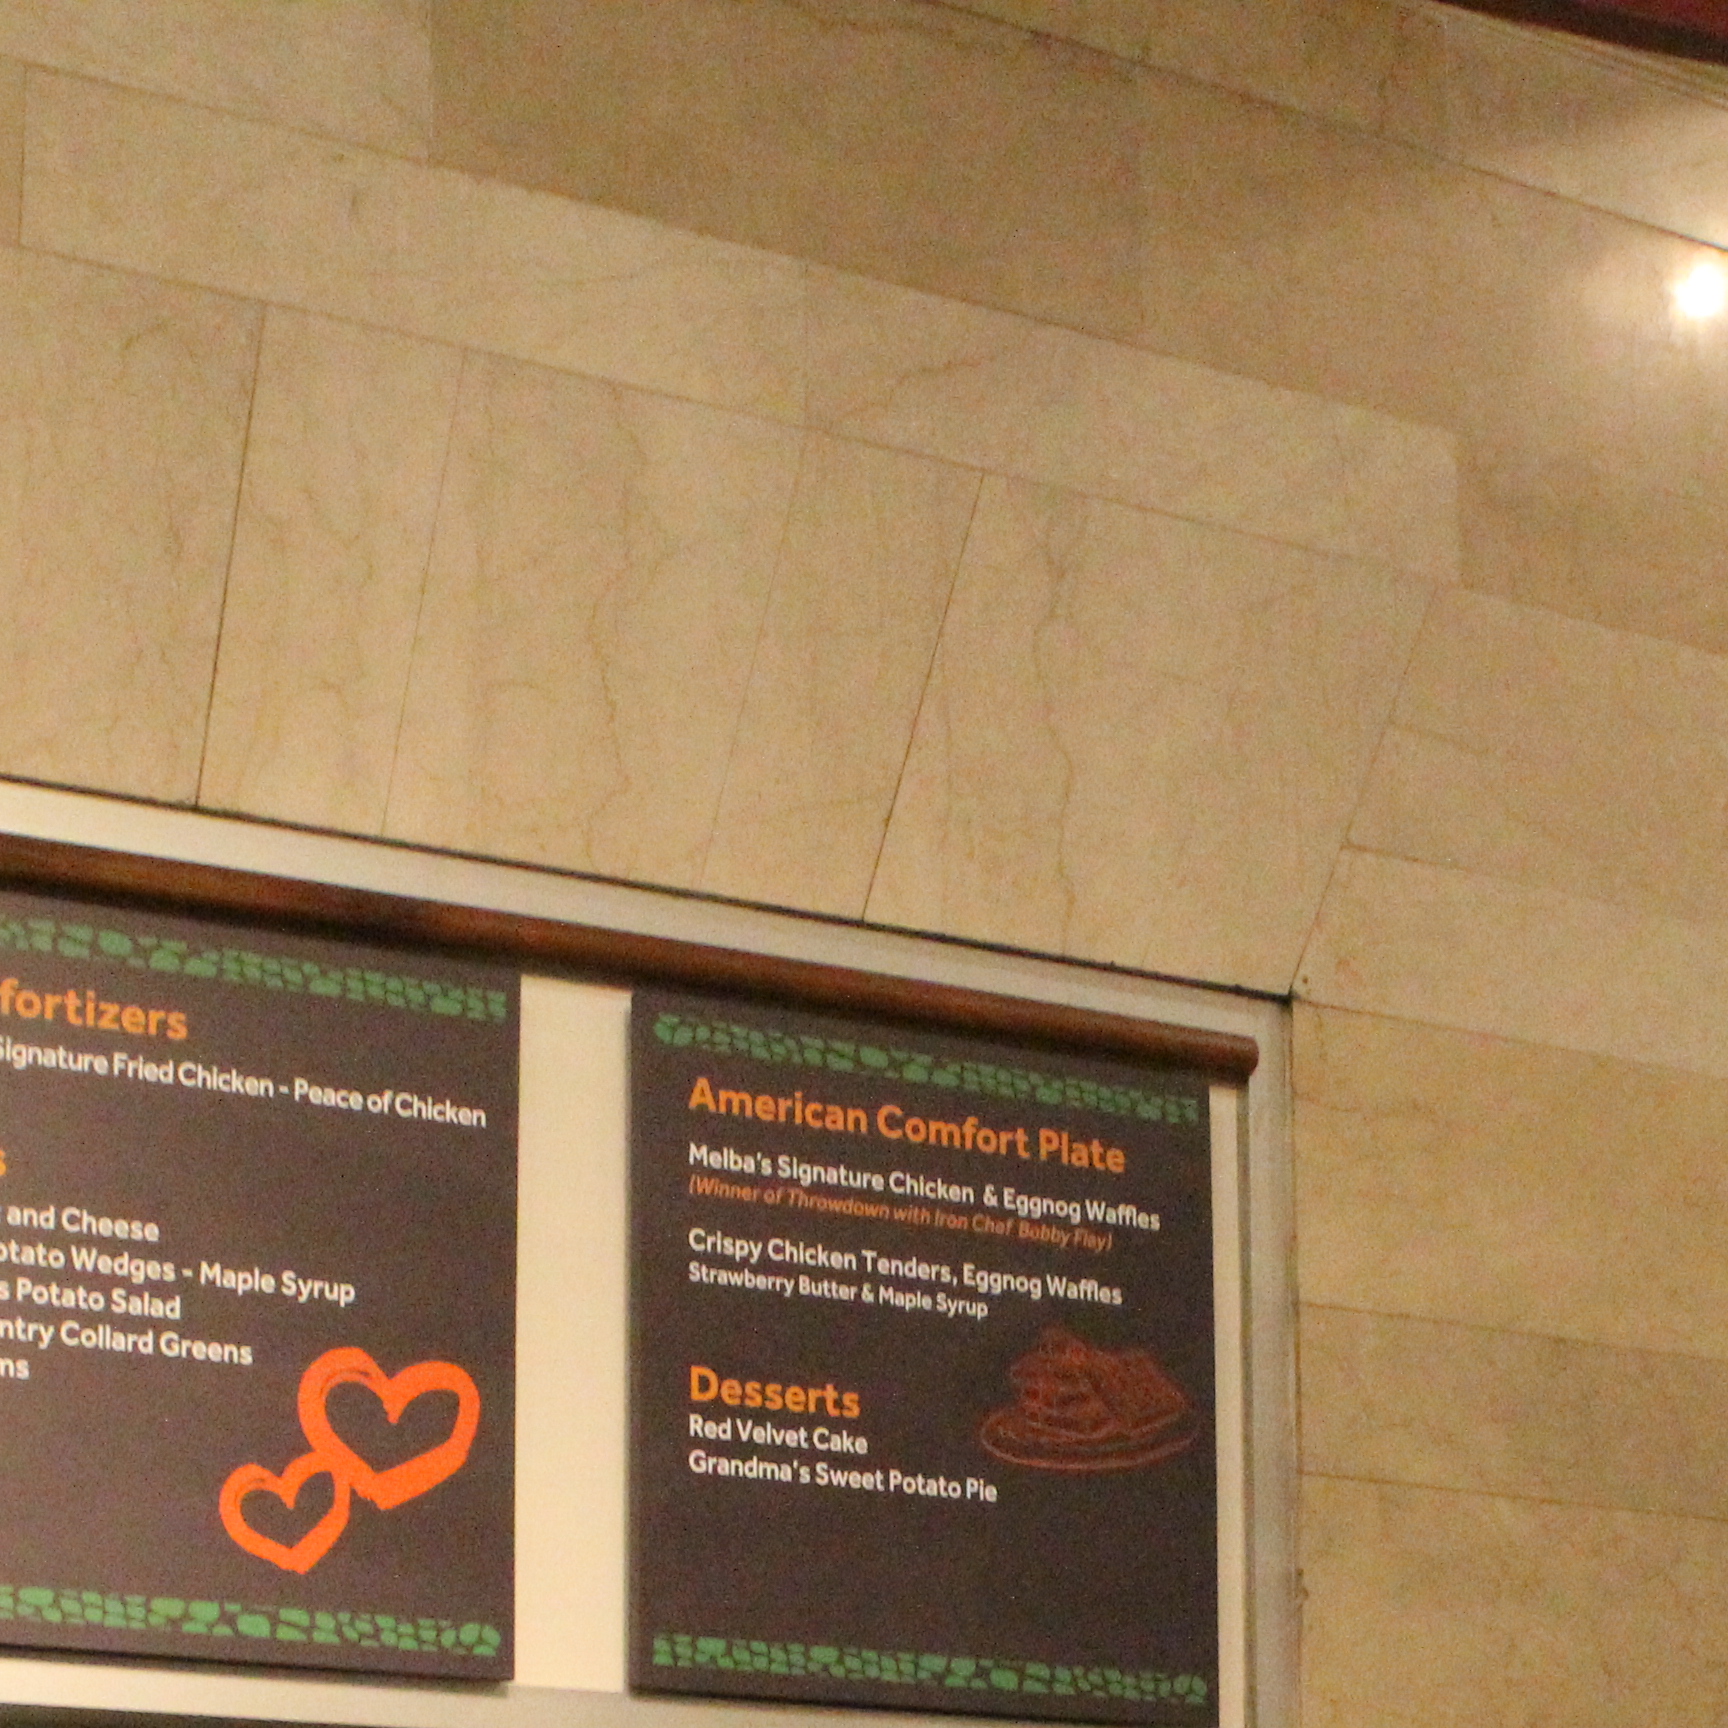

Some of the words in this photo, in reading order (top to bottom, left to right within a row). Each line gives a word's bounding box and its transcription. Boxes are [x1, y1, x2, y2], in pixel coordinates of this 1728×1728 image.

[112, 1051, 175, 1084] Fried
[177, 1061, 275, 1098] Chicken
[293, 1077, 364, 1111] Peace
[366, 1090, 394, 1114] of
[394, 1092, 487, 1128] Chicken
[689, 1077, 868, 1133] American
[876, 1104, 1030, 1158] Comfort
[1039, 1128, 1126, 1173] Plate
[688, 1143, 773, 1176] Melba's
[777, 1155, 885, 1192] Signature
[888, 1170, 975, 1204] Chicken
[982, 1184, 999, 1207] &
[1002, 1187, 1082, 1225] Eggnog
[1085, 1199, 1161, 1231] Waffles
[6, 1205, 56, 1230] and
[61, 1207, 160, 1243] Cheese
[70, 1246, 176, 1285] Wedges
[199, 1261, 276, 1296] Maple
[281, 1270, 356, 1308] Syrup
[688, 1228, 763, 1264] Crispy
[766, 1238, 857, 1271] Chicken
[861, 1249, 958, 1286] Tenders,
[962, 1262, 1043, 1301] Eggnog
[1045, 1274, 1123, 1306] Waffles
[688, 1262, 795, 1298] Strawberry
[798, 1275, 858, 1301] Butter
[861, 1283, 875, 1303] &
[878, 1285, 933, 1311] Maple
[936, 1292, 989, 1321] Syrup
[16, 1277, 105, 1311] Potato
[111, 1288, 181, 1320] Salad
[59, 1320, 154, 1355] Collard
[159, 1331, 253, 1366] Greens
[690, 1365, 861, 1418] Desserts
[688, 1414, 732, 1441] Red
[736, 1418, 809, 1449] Velvet
[812, 1426, 868, 1455] Cake
[688, 1449, 811, 1484] Grandma's
[815, 1461, 885, 1492] Sweet
[888, 1469, 962, 1499] Potato
[965, 1477, 998, 1503] Pie
